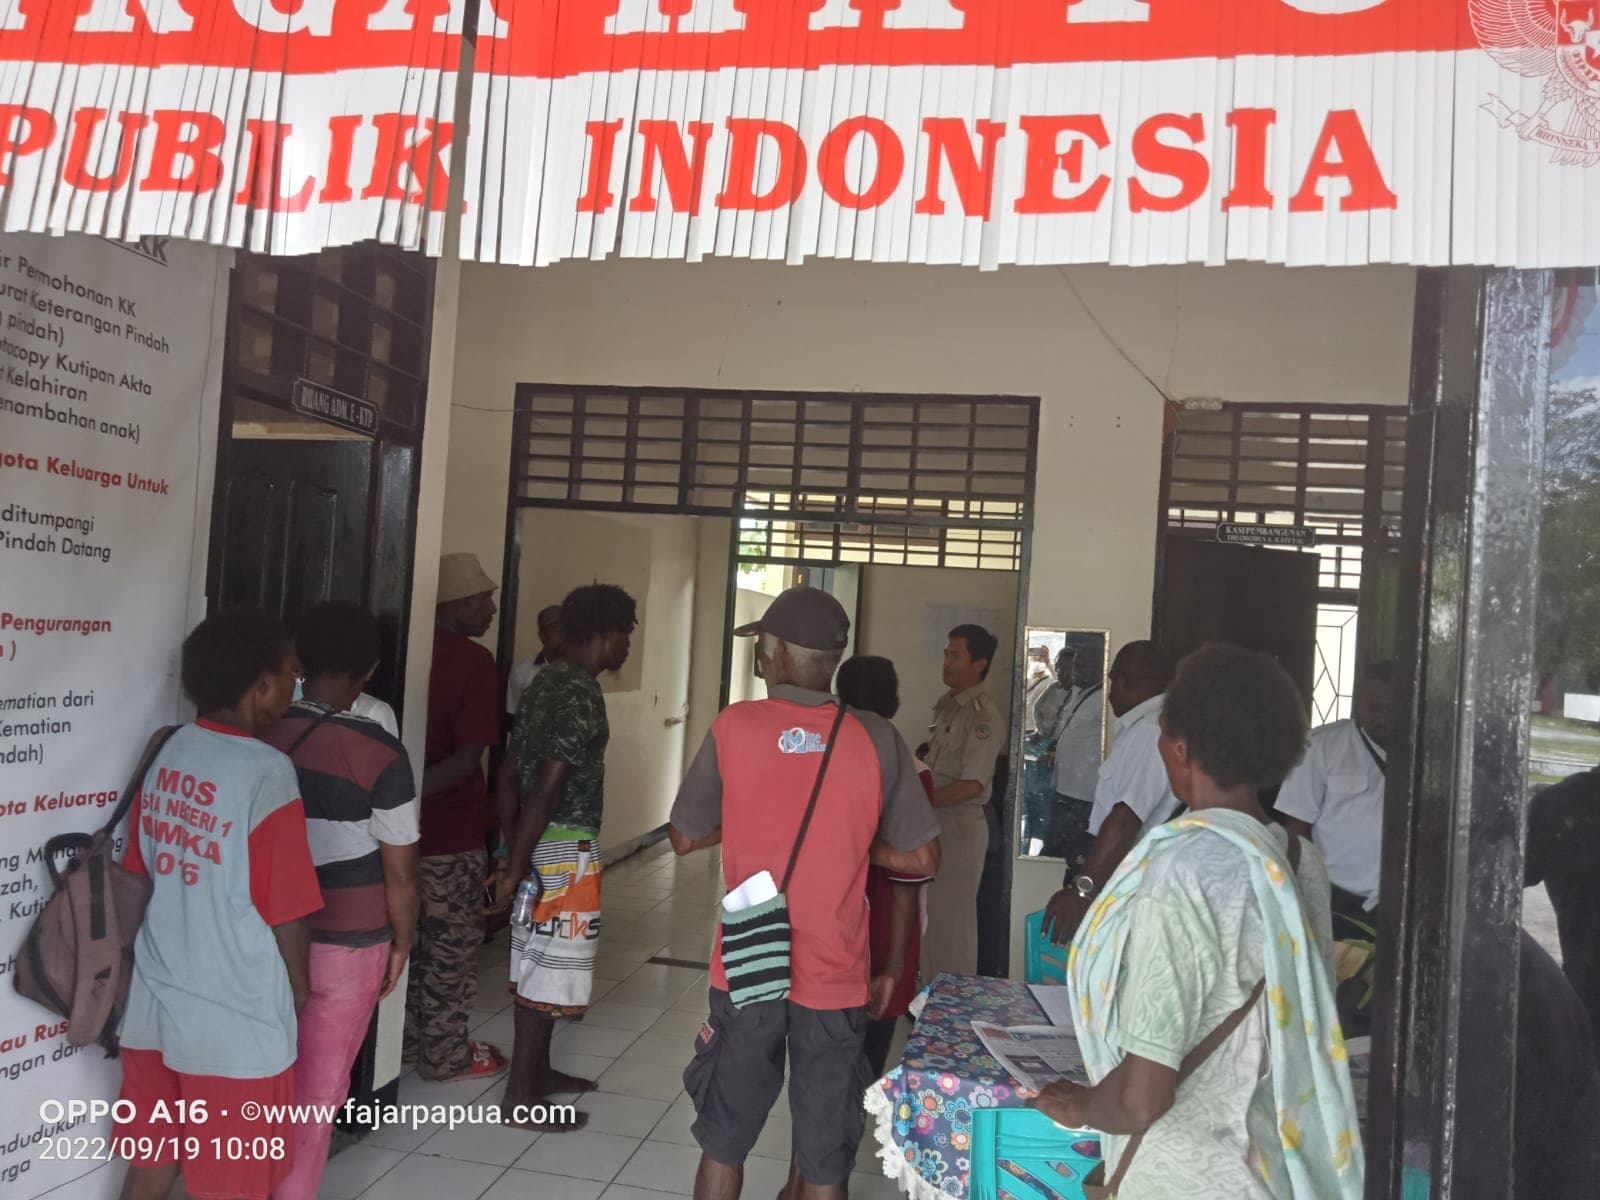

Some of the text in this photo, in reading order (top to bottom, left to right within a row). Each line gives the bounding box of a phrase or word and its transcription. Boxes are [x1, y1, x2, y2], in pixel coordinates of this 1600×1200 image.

[0, 104, 1397, 222] PUBLIK INDONESIA
[18, 256, 113, 308] Permohonan
[118, 296, 136, 317] KK
[8, 311, 64, 348] pindah)
[30, 292, 121, 334] Keterangan
[126, 323, 169, 354] Pindah
[6, 365, 88, 402] Kelahiran
[56, 352, 115, 385] Kutipan
[119, 374, 152, 396] Akta
[100, 420, 141, 444] anak)
[46, 456, 122, 488] Keluarga
[127, 472, 169, 496] Untuk
[2, 503, 95, 536] ditumpangi
[61, 537, 112, 563] Datang
[1, 613, 112, 636] Pengurangan
[62, 690, 95, 709] dari
[33, 789, 119, 812] Keluarga
[156, 767, 218, 807] MOS
